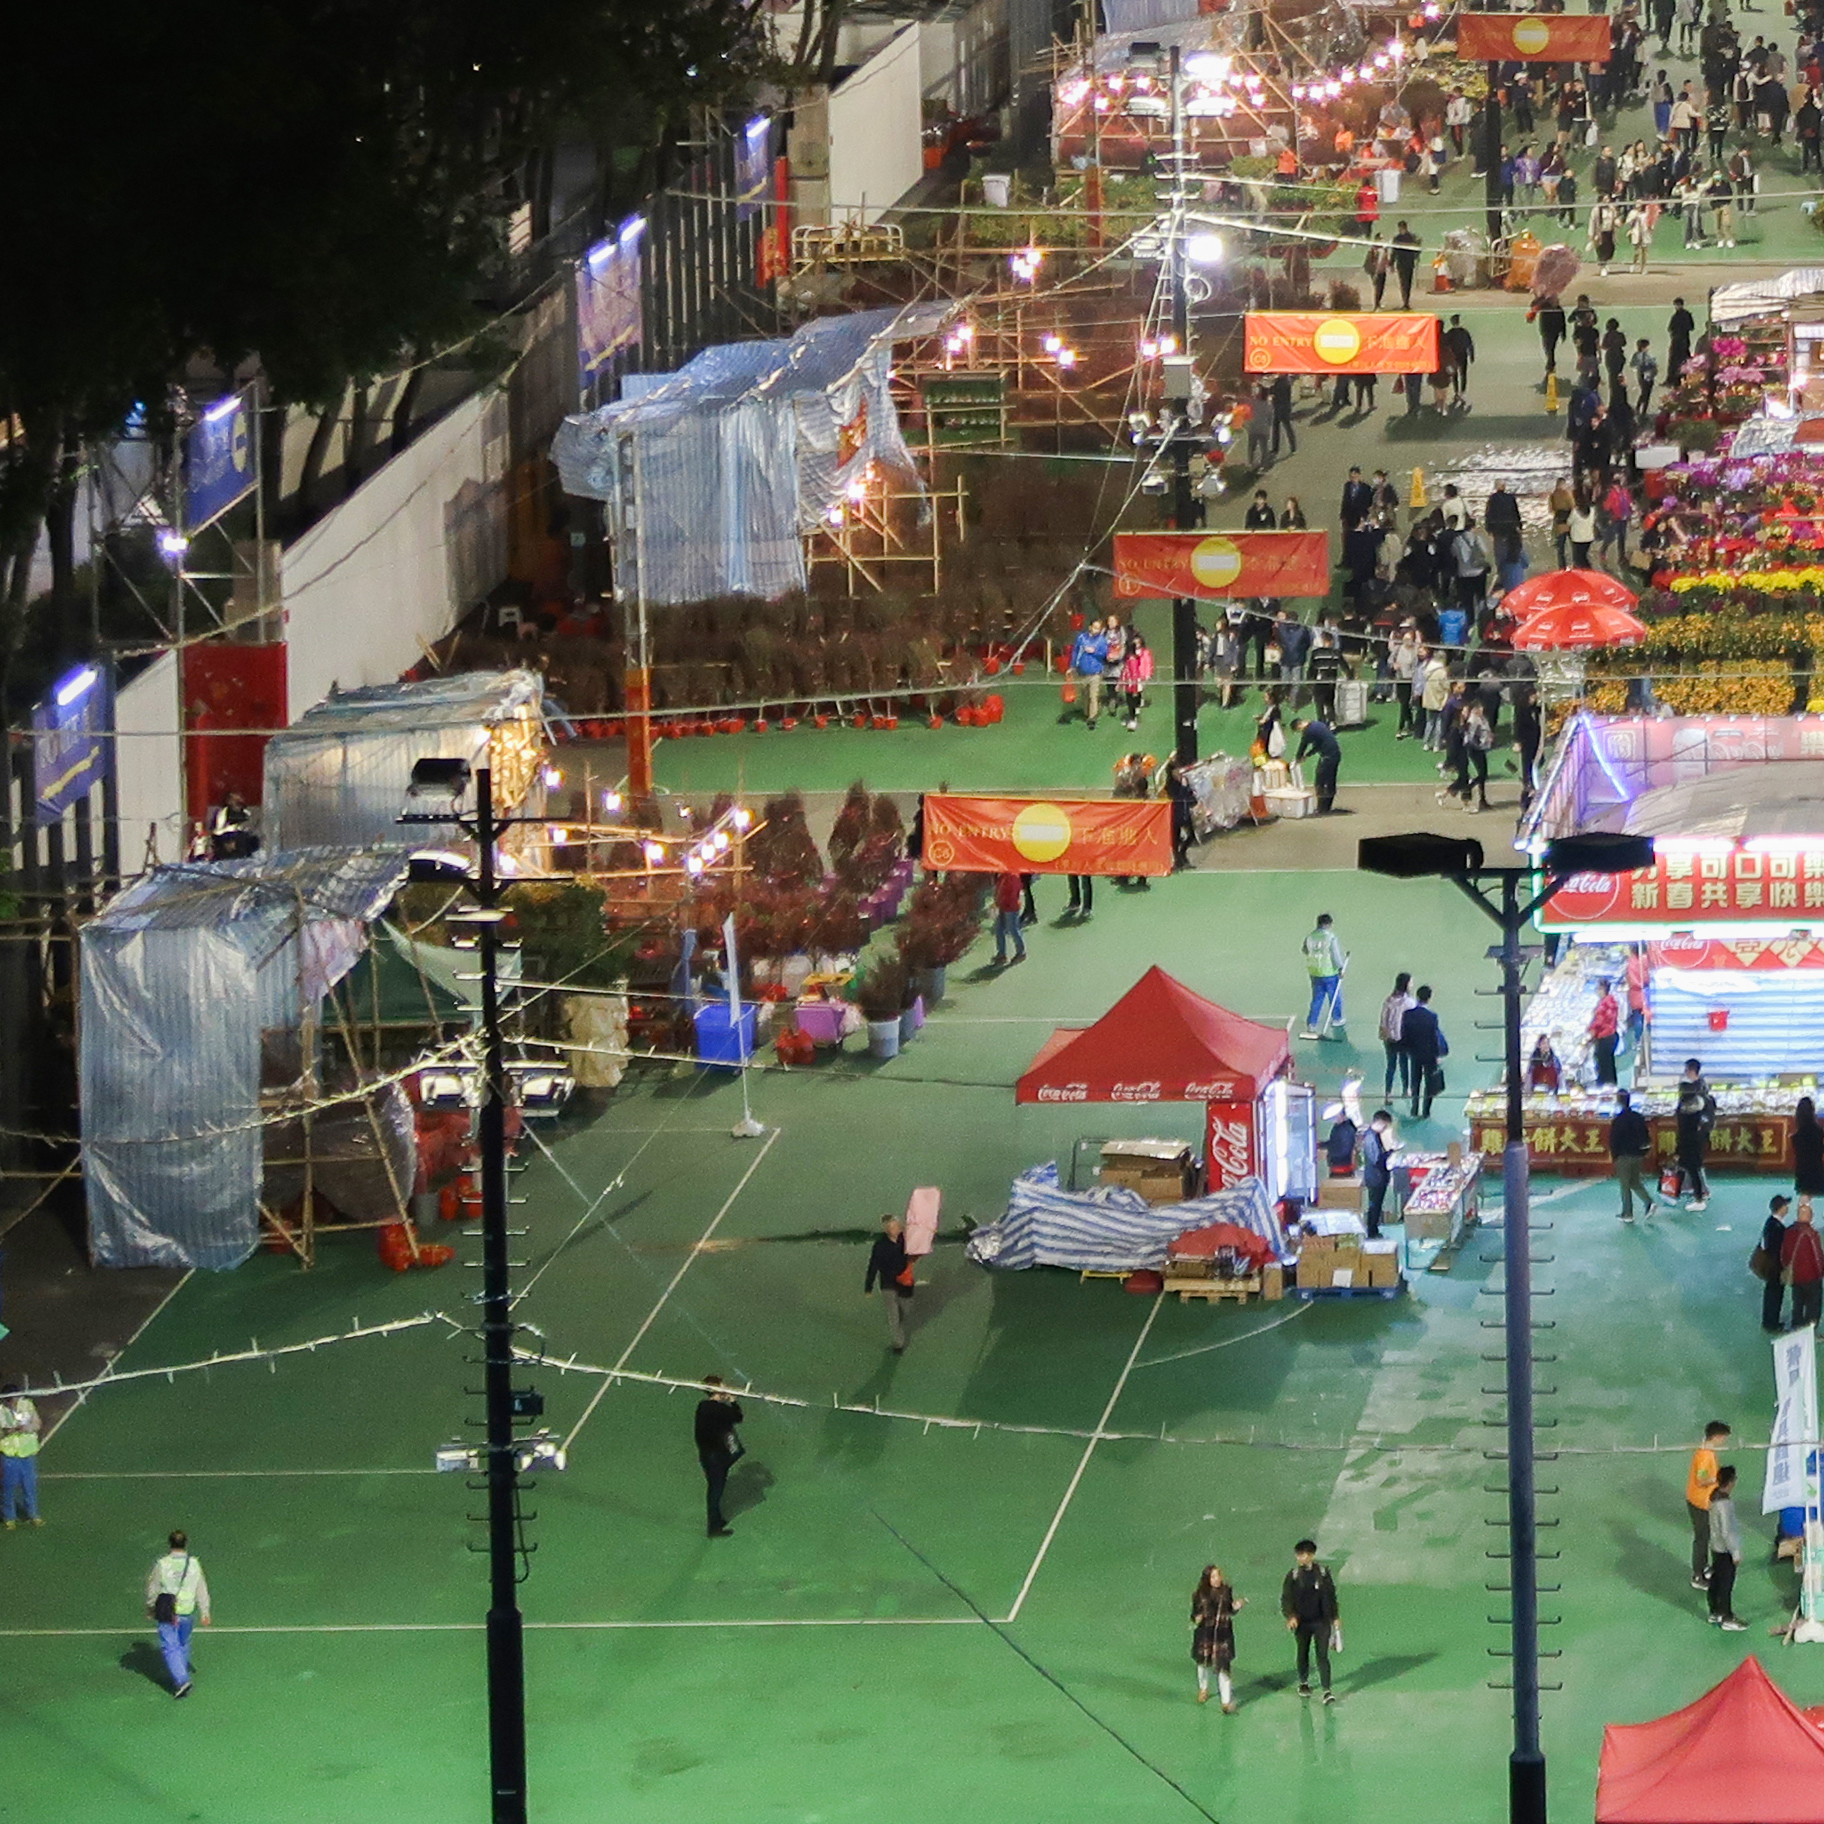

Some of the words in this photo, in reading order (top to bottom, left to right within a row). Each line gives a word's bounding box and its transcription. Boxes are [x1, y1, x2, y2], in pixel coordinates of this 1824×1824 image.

[1250, 336, 1268, 347] NO
[1273, 336, 1313, 347] ENTRY
[930, 823, 950, 836] NO
[957, 825, 1009, 840] ENTRY
[1038, 1083, 1088, 1101] Coca-Cola
[1481, 1127, 1605, 1155] 雞餅大王
